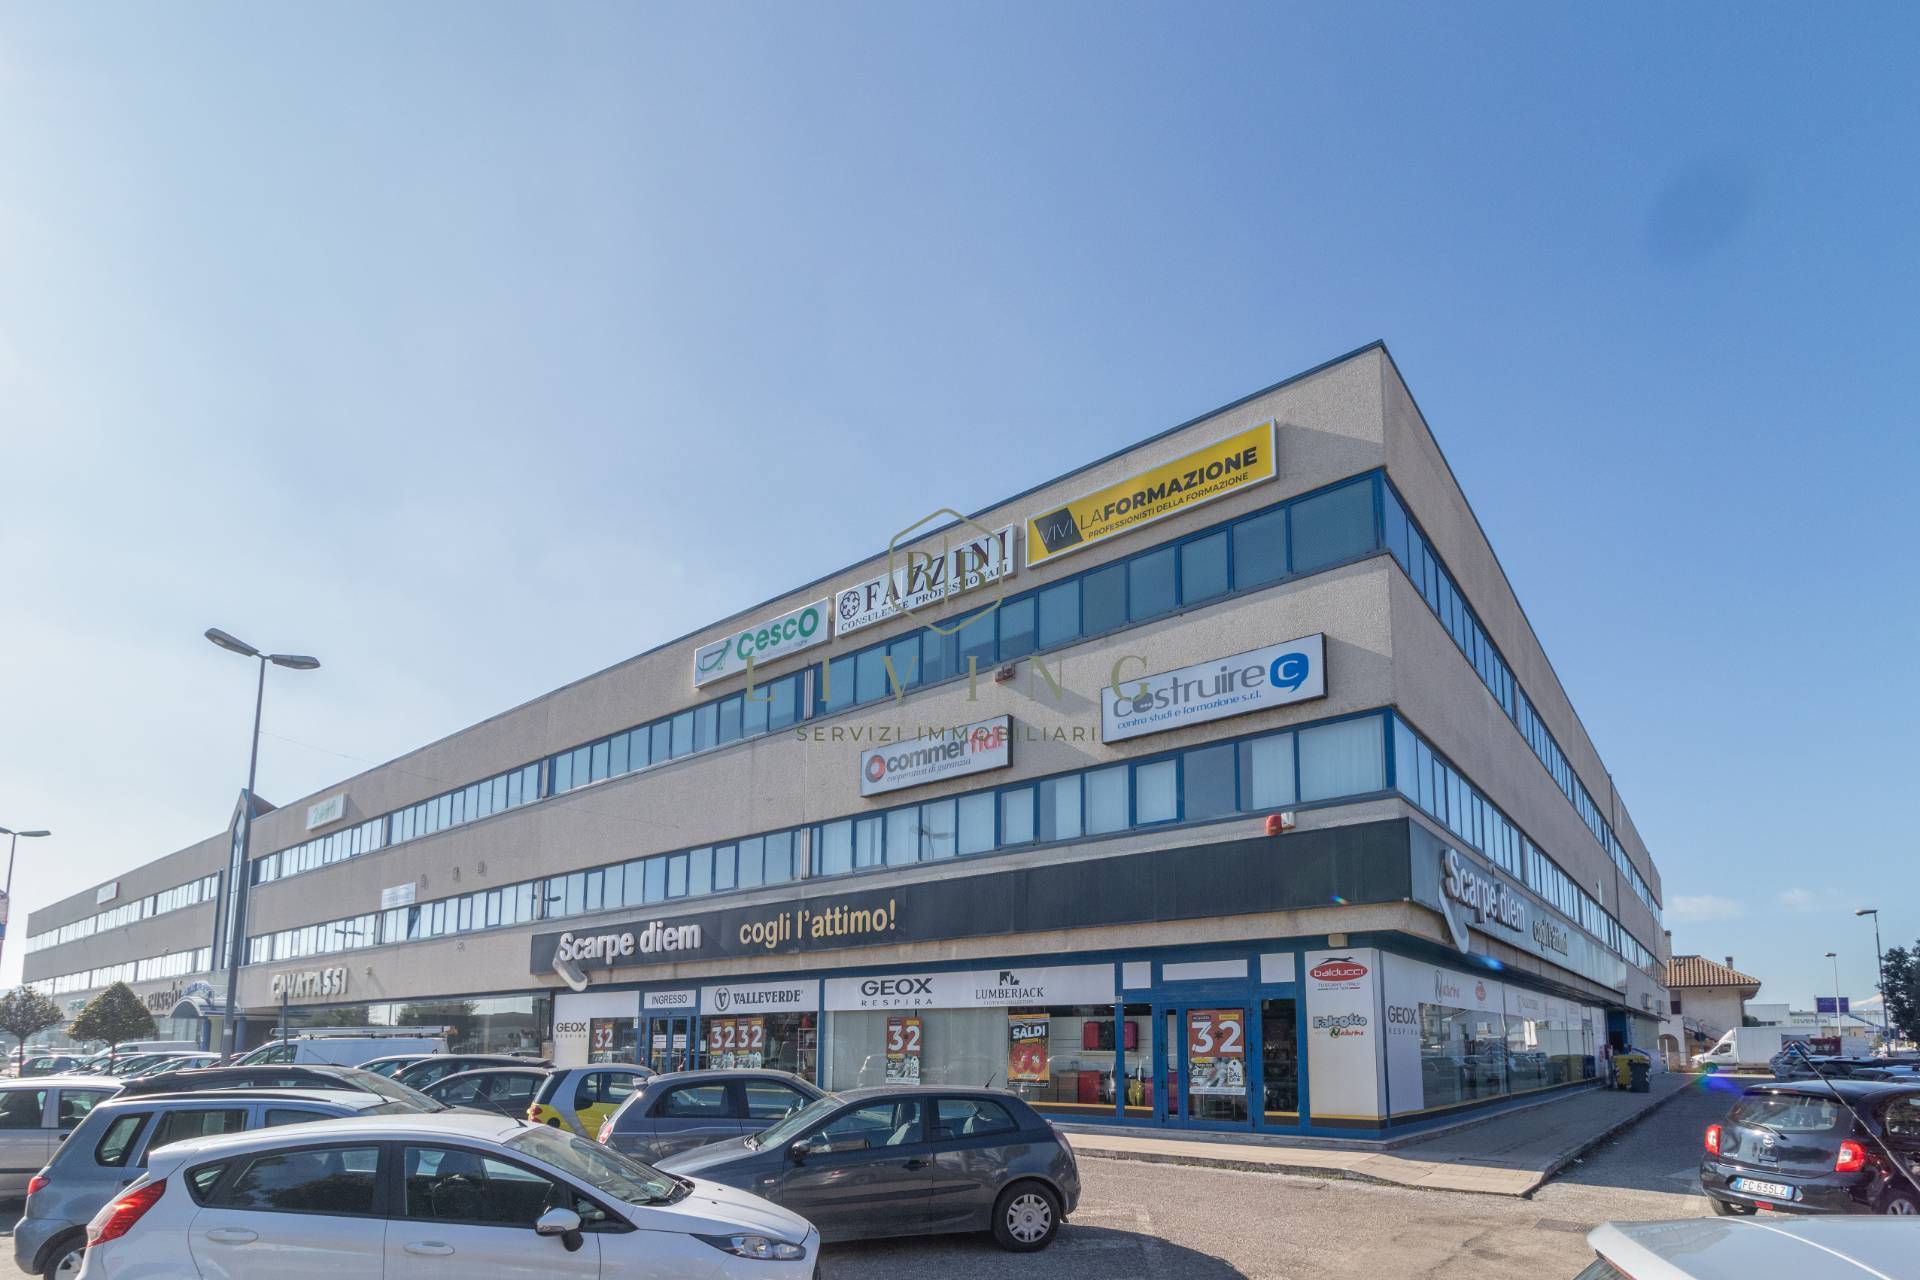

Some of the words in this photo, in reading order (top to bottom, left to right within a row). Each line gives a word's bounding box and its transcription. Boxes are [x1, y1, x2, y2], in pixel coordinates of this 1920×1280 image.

[1088, 508, 1156, 539] PROFESSIONISTI
[1156, 498, 1185, 513] DELLA
[1186, 472, 1249, 502] FORMAZIONE
[864, 530, 1009, 612] FAZZINI
[1117, 718, 1148, 729] centro
[1150, 710, 1172, 721] studi
[1183, 696, 1240, 715] formazione
[1445, 848, 1498, 924] Scarpe
[1499, 883, 1525, 933] diem
[739, 912, 791, 949] cogli
[797, 898, 896, 939] l'attimo!
[558, 931, 635, 964] Scarpe
[639, 921, 702, 953] diem
[1313, 967, 1364, 977] balducci
[272, 967, 348, 1000] CAVATASSI
[860, 977, 934, 996] GEOX
[651, 993, 688, 1005] INGRESSO
[733, 989, 801, 1005] VALLEVERDE
[861, 998, 934, 1007] RESPIRA
[975, 987, 1045, 1000] LUMBERJACK
[1312, 1012, 1368, 1029] Falcotto
[1387, 1005, 1417, 1024] GEOX
[556, 1021, 587, 1033] GEOX
[1012, 1024, 1046, 1040] SALDI
